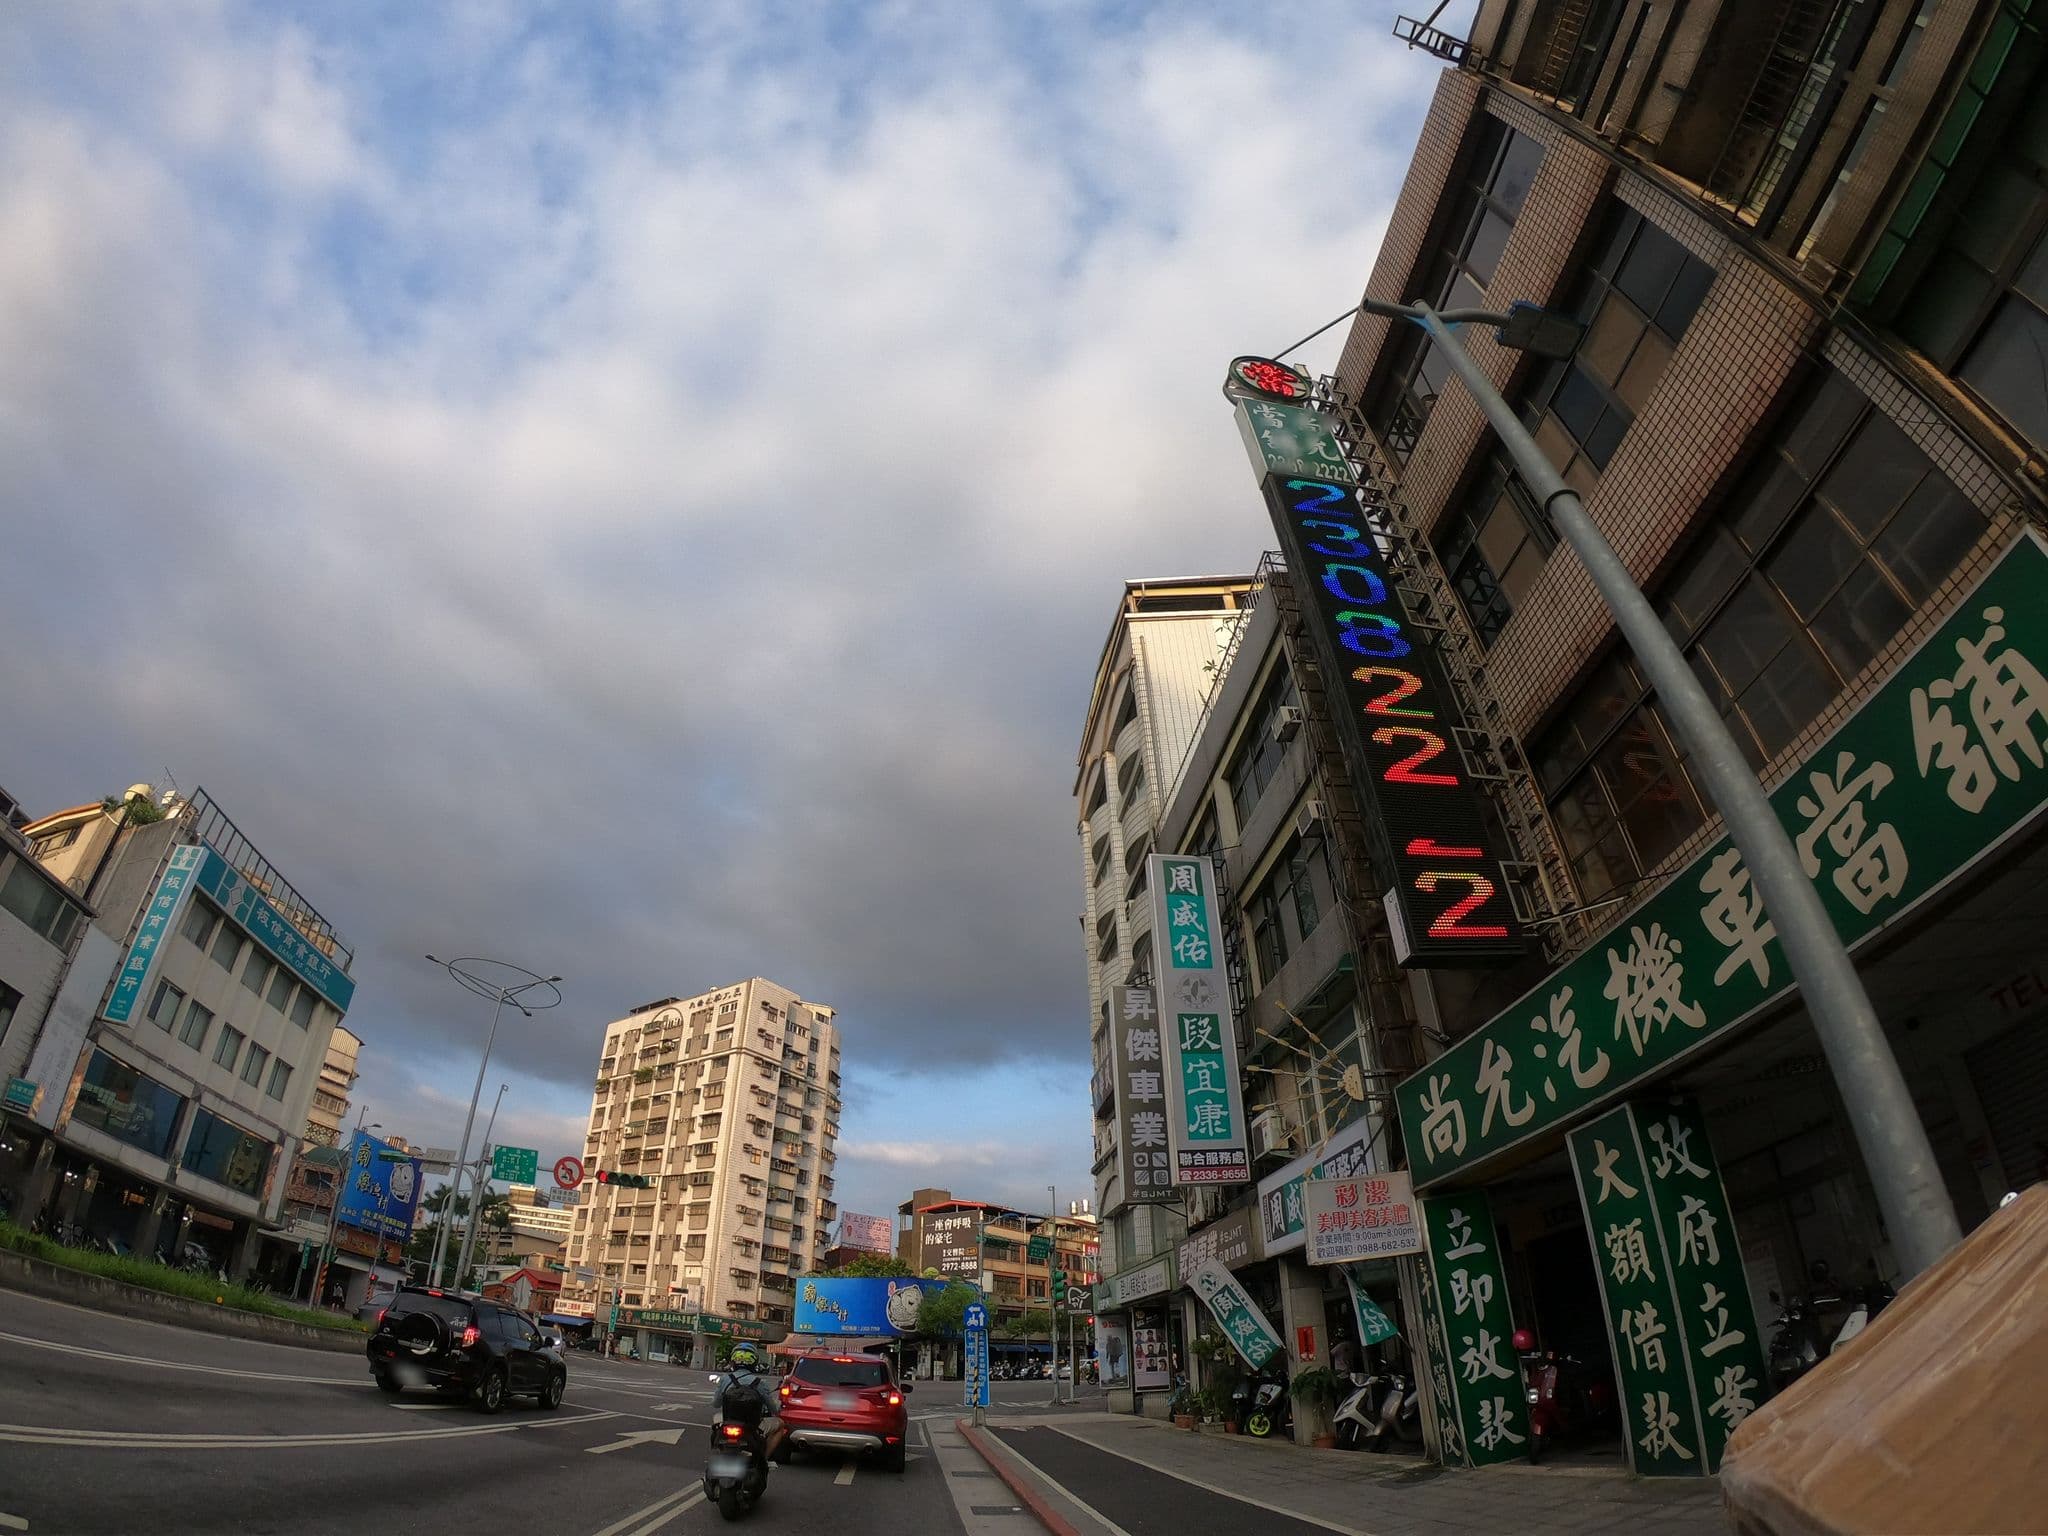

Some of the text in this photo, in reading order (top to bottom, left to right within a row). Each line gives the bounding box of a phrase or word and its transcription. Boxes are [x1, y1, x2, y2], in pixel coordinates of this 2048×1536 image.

[121, 874, 181, 992] 板信商業銀行
[256, 906, 332, 979] 板信商業銀行
[1169, 865, 1208, 964] 周威佑
[1123, 990, 1167, 1147] 昇傑車業
[1180, 1016, 1229, 1137] 段宜康
[1179, 1151, 1245, 1166] 聯合服務處
[1270, 1180, 1307, 1234] 周威
[925, 1217, 971, 1231] 一座會呼吸
[925, 1233, 953, 1245] 的豪宅
[1444, 1207, 1526, 1452] 立即放款
[1594, 1139, 1695, 1460] 大額借款
